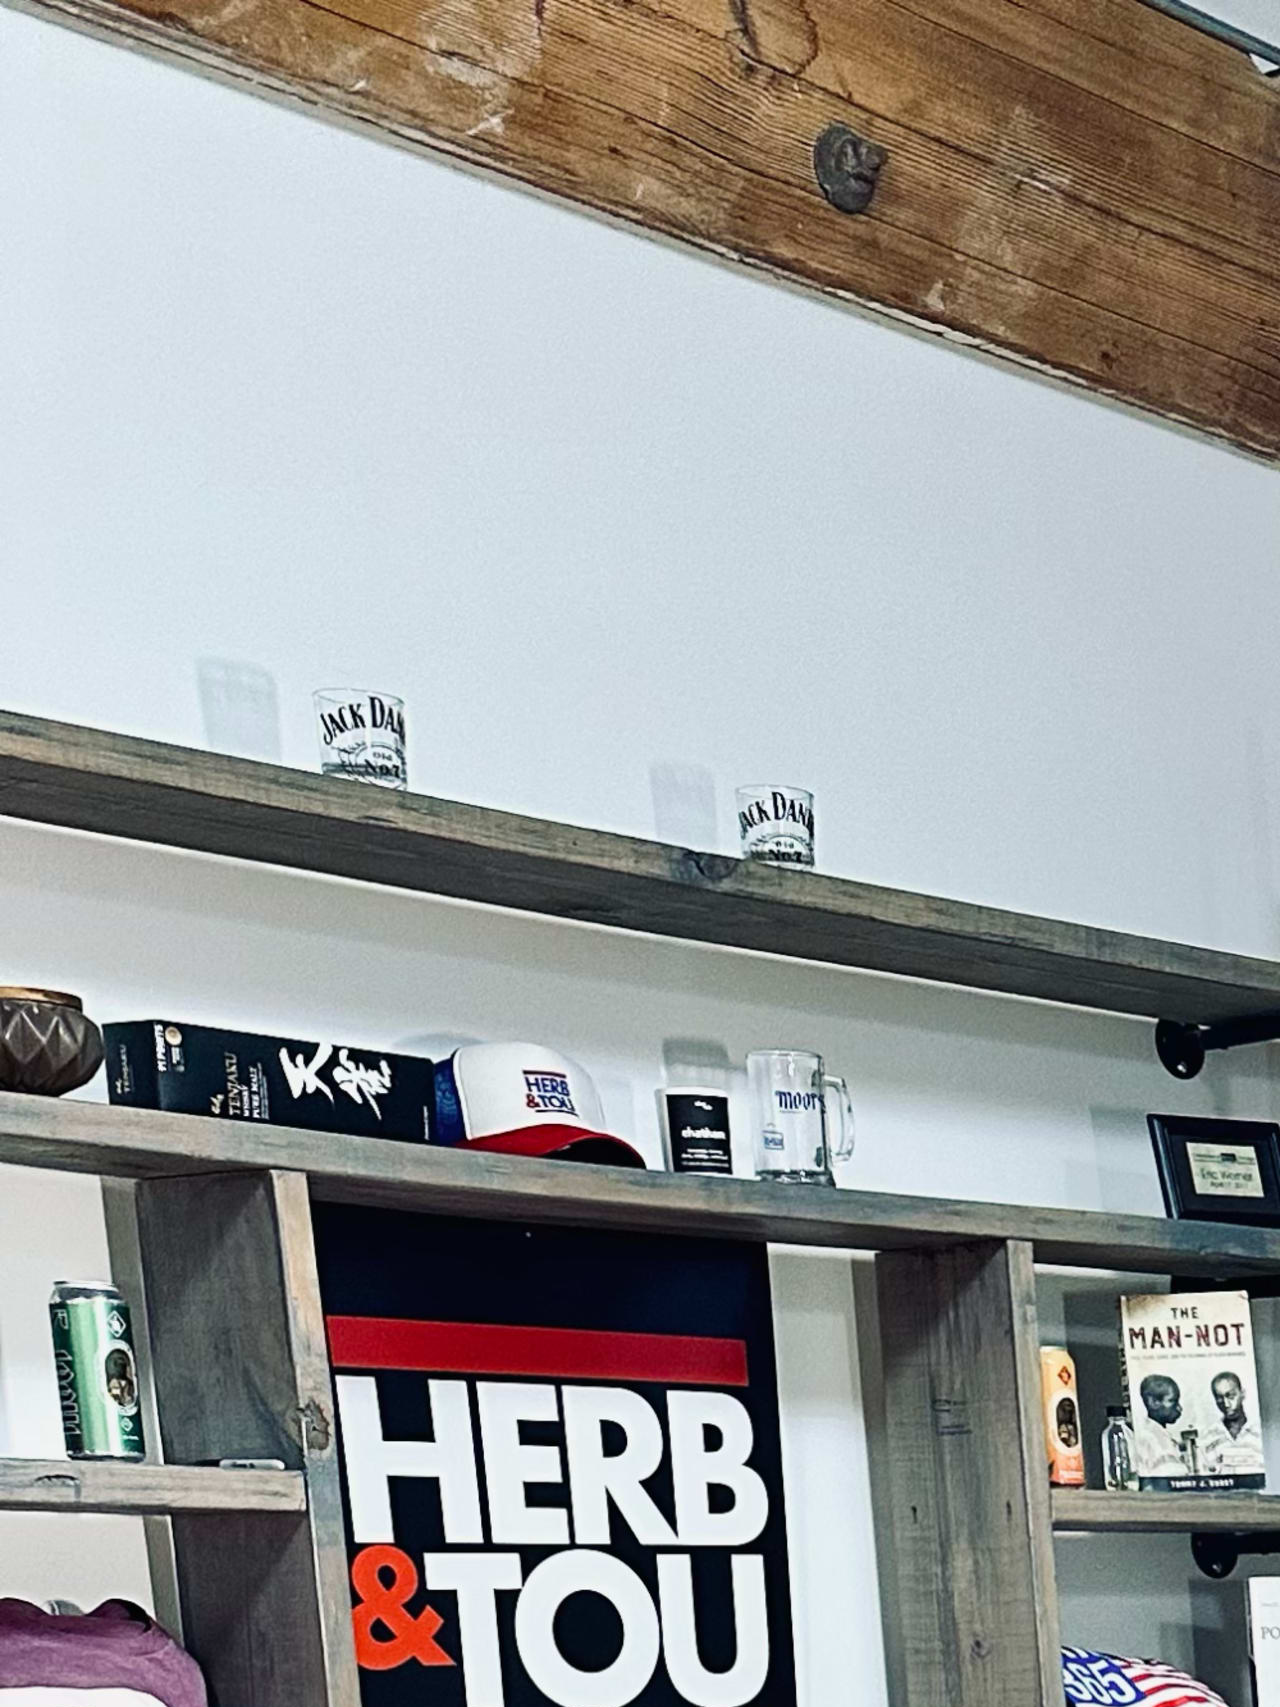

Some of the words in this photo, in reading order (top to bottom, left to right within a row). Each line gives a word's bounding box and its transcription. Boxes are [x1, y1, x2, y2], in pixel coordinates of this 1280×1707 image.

[320, 703, 366, 745] JACK
[525, 1076, 570, 1097] HERB
[1171, 1306, 1199, 1319] THE
[1128, 1323, 1246, 1350] MAN-NOT
[335, 1375, 770, 1546] HERB
